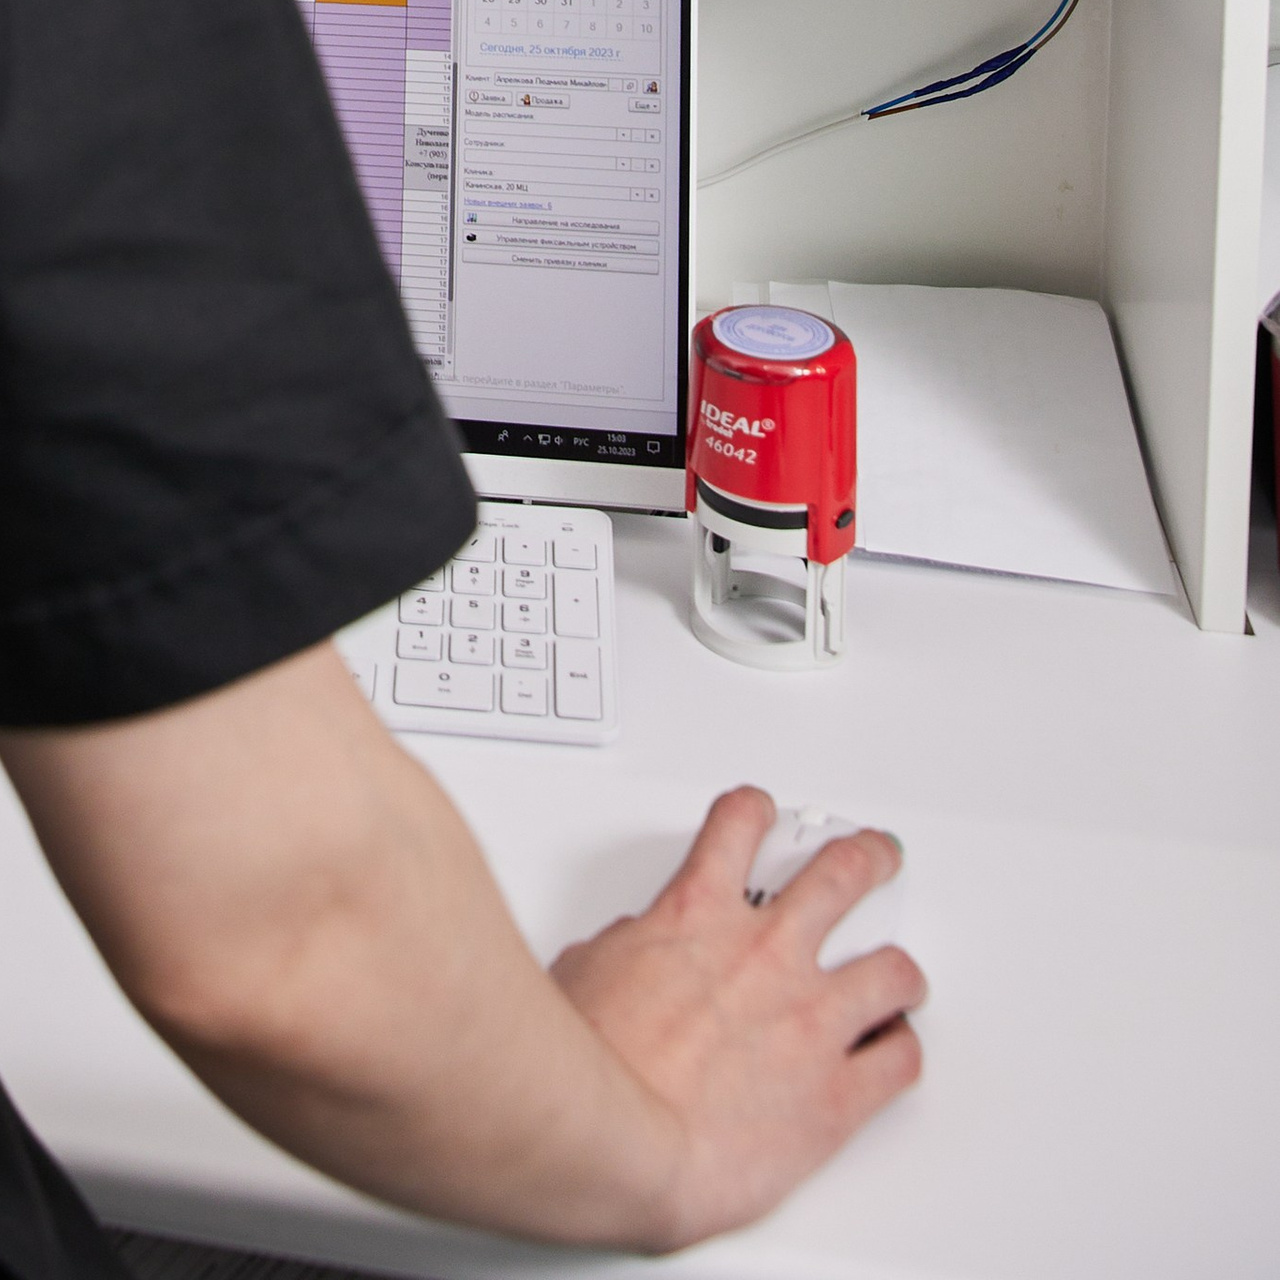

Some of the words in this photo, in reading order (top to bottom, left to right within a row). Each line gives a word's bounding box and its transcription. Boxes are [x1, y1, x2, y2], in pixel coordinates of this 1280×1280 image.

[616, 0, 623, 8] 2
[642, 0, 650, 10] 3
[484, 17, 491, 26] 4
[511, 18, 518, 27] 5
[537, 19, 544, 28] 6
[563, 20, 570, 30] 7
[589, 21, 596, 31] 8
[616, 23, 623, 32] 9
[641, 24, 653, 33] 10
[529, 44, 542, 54] 25
[544, 46, 586, 59] октября
[588, 47, 614, 58] 2023
[535, 77, 568, 86] Людмила
[480, 93, 505, 102] Заявка
[532, 95, 563, 106] Продажа
[465, 109, 491, 117] Модель
[506, 182, 515, 191] 20
[516, 183, 528, 192] МЦ
[512, 216, 558, 227] Направление
[571, 222, 620, 231] исследования
[496, 234, 538, 245] Управление
[591, 240, 636, 251] устройством
[511, 254, 542, 264] Сменить
[544, 258, 576, 268] привязку
[578, 260, 608, 268] клиники
[462, 374, 514, 386] перейдите
[524, 379, 557, 390] раздел
[573, 437, 589, 446] РУС
[607, 433, 627, 443] 15:03
[597, 445, 636, 457] 25.10.2023
[705, 436, 757, 465] 46042
[470, 566, 479, 574] 8
[520, 570, 530, 578] 9
[469, 600, 479, 608] 5
[519, 604, 530, 612] 6
[419, 630, 424, 639] 1
[468, 634, 478, 642] 2
[520, 639, 531, 647] 3
